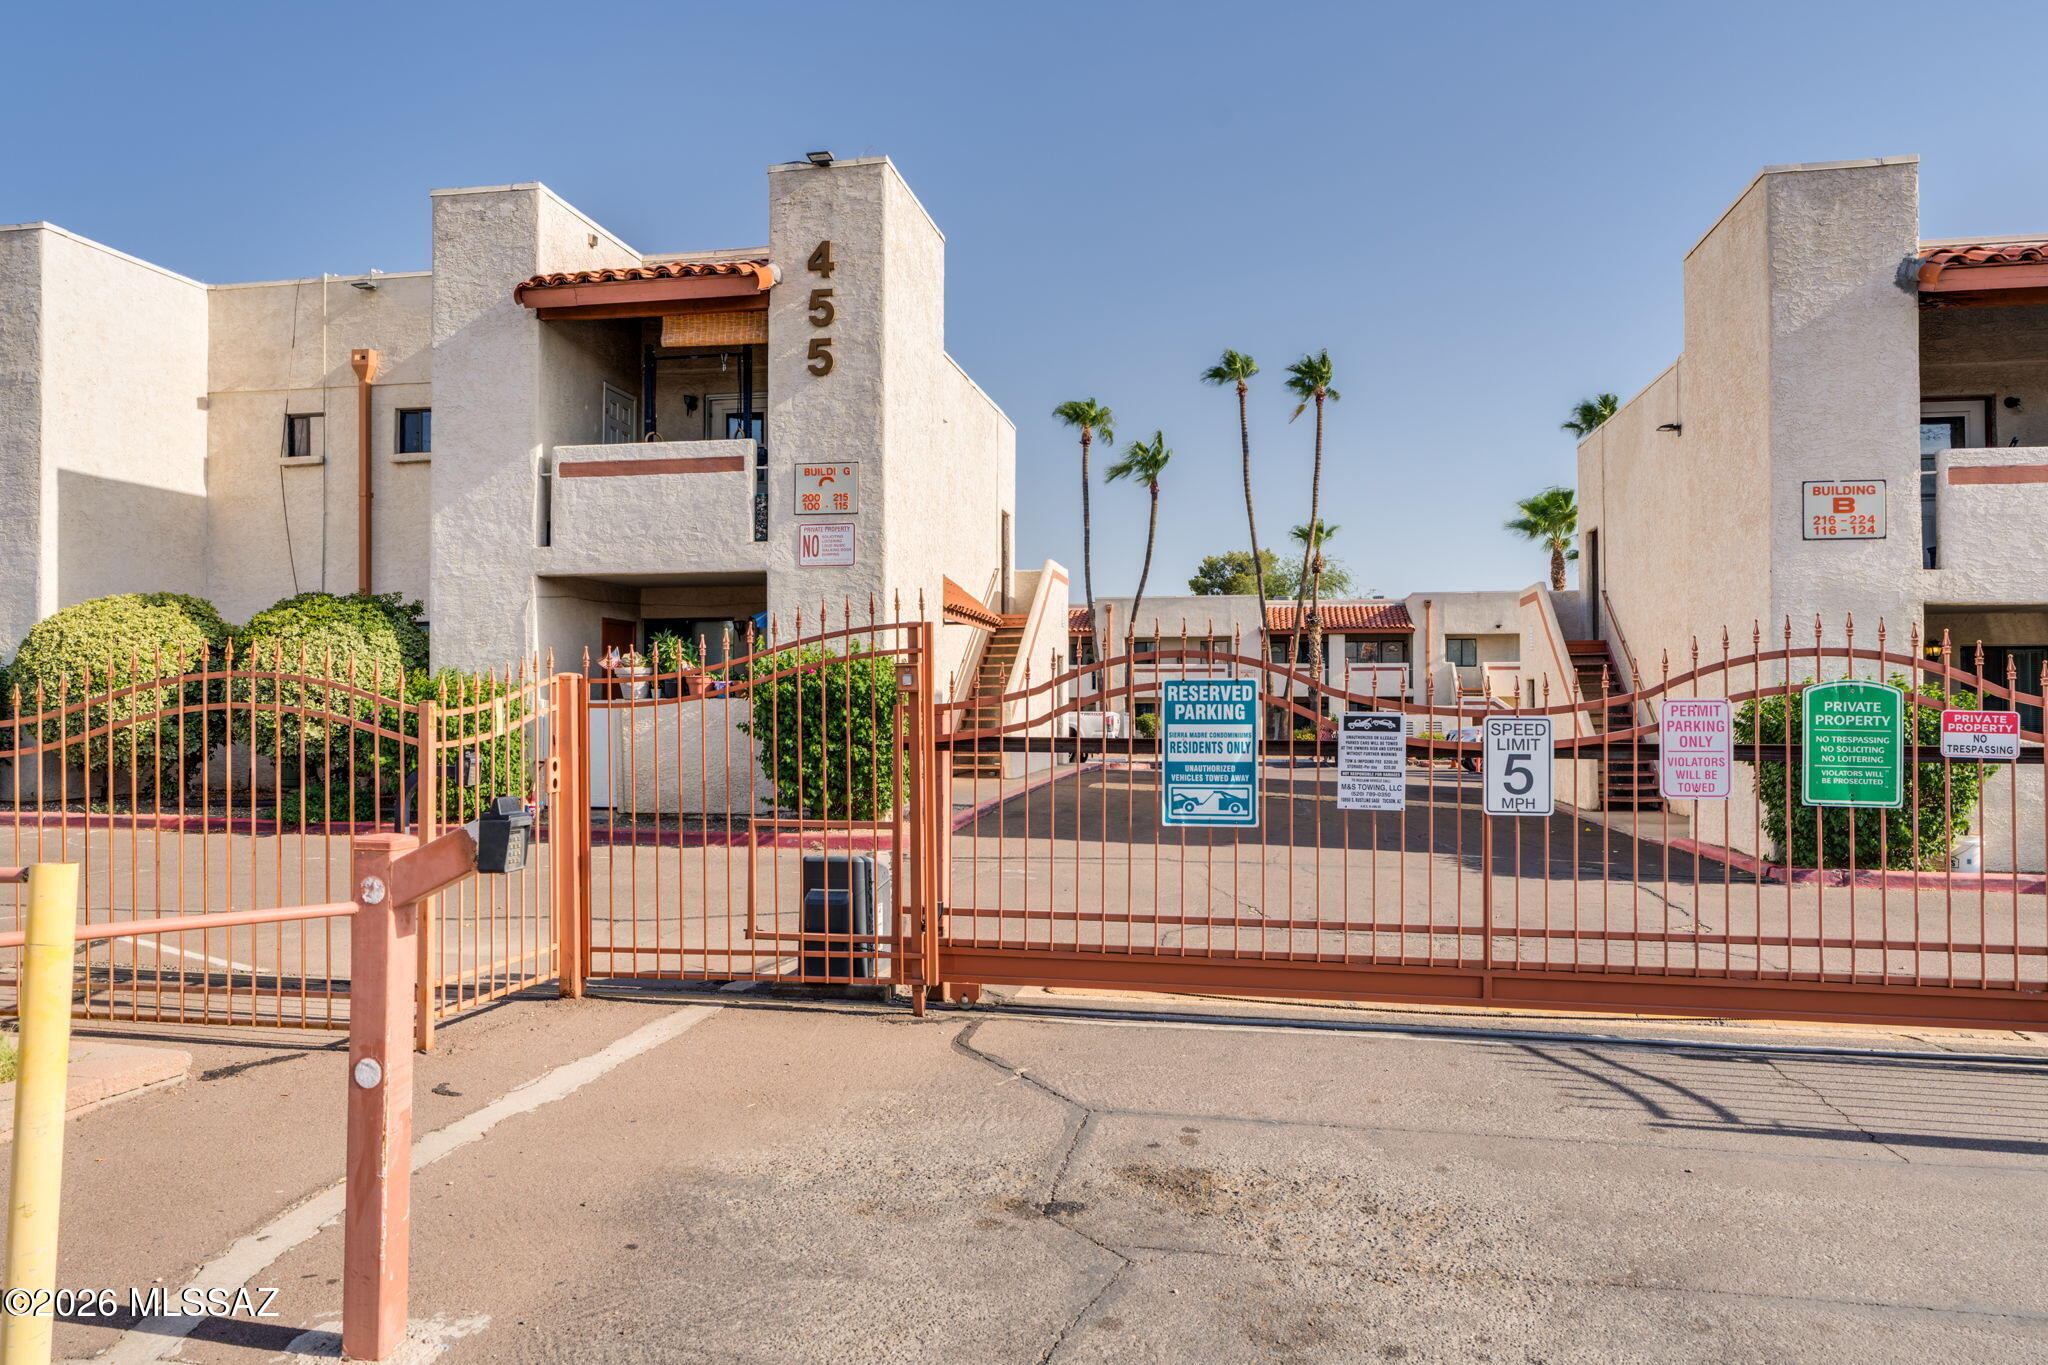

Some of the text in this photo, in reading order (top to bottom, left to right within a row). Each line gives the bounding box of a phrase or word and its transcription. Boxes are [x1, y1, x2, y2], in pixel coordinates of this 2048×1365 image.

[807, 240, 836, 376] 455
[1812, 485, 1876, 496] BUILDING
[802, 493, 849, 502] 200 215
[803, 502, 849, 511] 100 115
[1832, 497, 1856, 514] B
[1813, 515, 1837, 525] 216
[1849, 515, 1876, 525] 224
[1814, 526, 1837, 535] 116
[1851, 525, 1876, 535] 124
[802, 535, 819, 558] NO
[1167, 685, 1253, 702] RESERVED
[1174, 704, 1246, 720] PARKING
[1670, 705, 1721, 717] PERMIT
[1824, 701, 1882, 713] PRIVATE
[1815, 715, 1891, 726] PROPERTY
[1954, 714, 2007, 724] PRIVATE
[1491, 723, 1546, 736] SPEED
[1667, 720, 1725, 732] PARKING
[1947, 723, 2013, 733] PROPERTY
[1679, 736, 1713, 747] ONLY
[1831, 736, 1890, 744] TRESPASSING
[1973, 734, 1987, 743] NO
[1170, 741, 1252, 754] RESIDENTS ONLY
[1497, 738, 1541, 751] LIMIT
[1836, 745, 1885, 753] SOLICITING
[1947, 744, 2014, 754] TRESPASSING
[1667, 757, 1726, 767] VIOLATORS
[1837, 755, 1884, 763] LOITERING
[1171, 774, 1250, 782] VEHICLES TOWED AWAY
[1503, 754, 1534, 795] 5
[1675, 770, 1718, 779] WILL BE
[1389, 784, 1402, 792] LLC
[1677, 782, 1715, 793] TOWED
[1502, 798, 1536, 809] MPH
